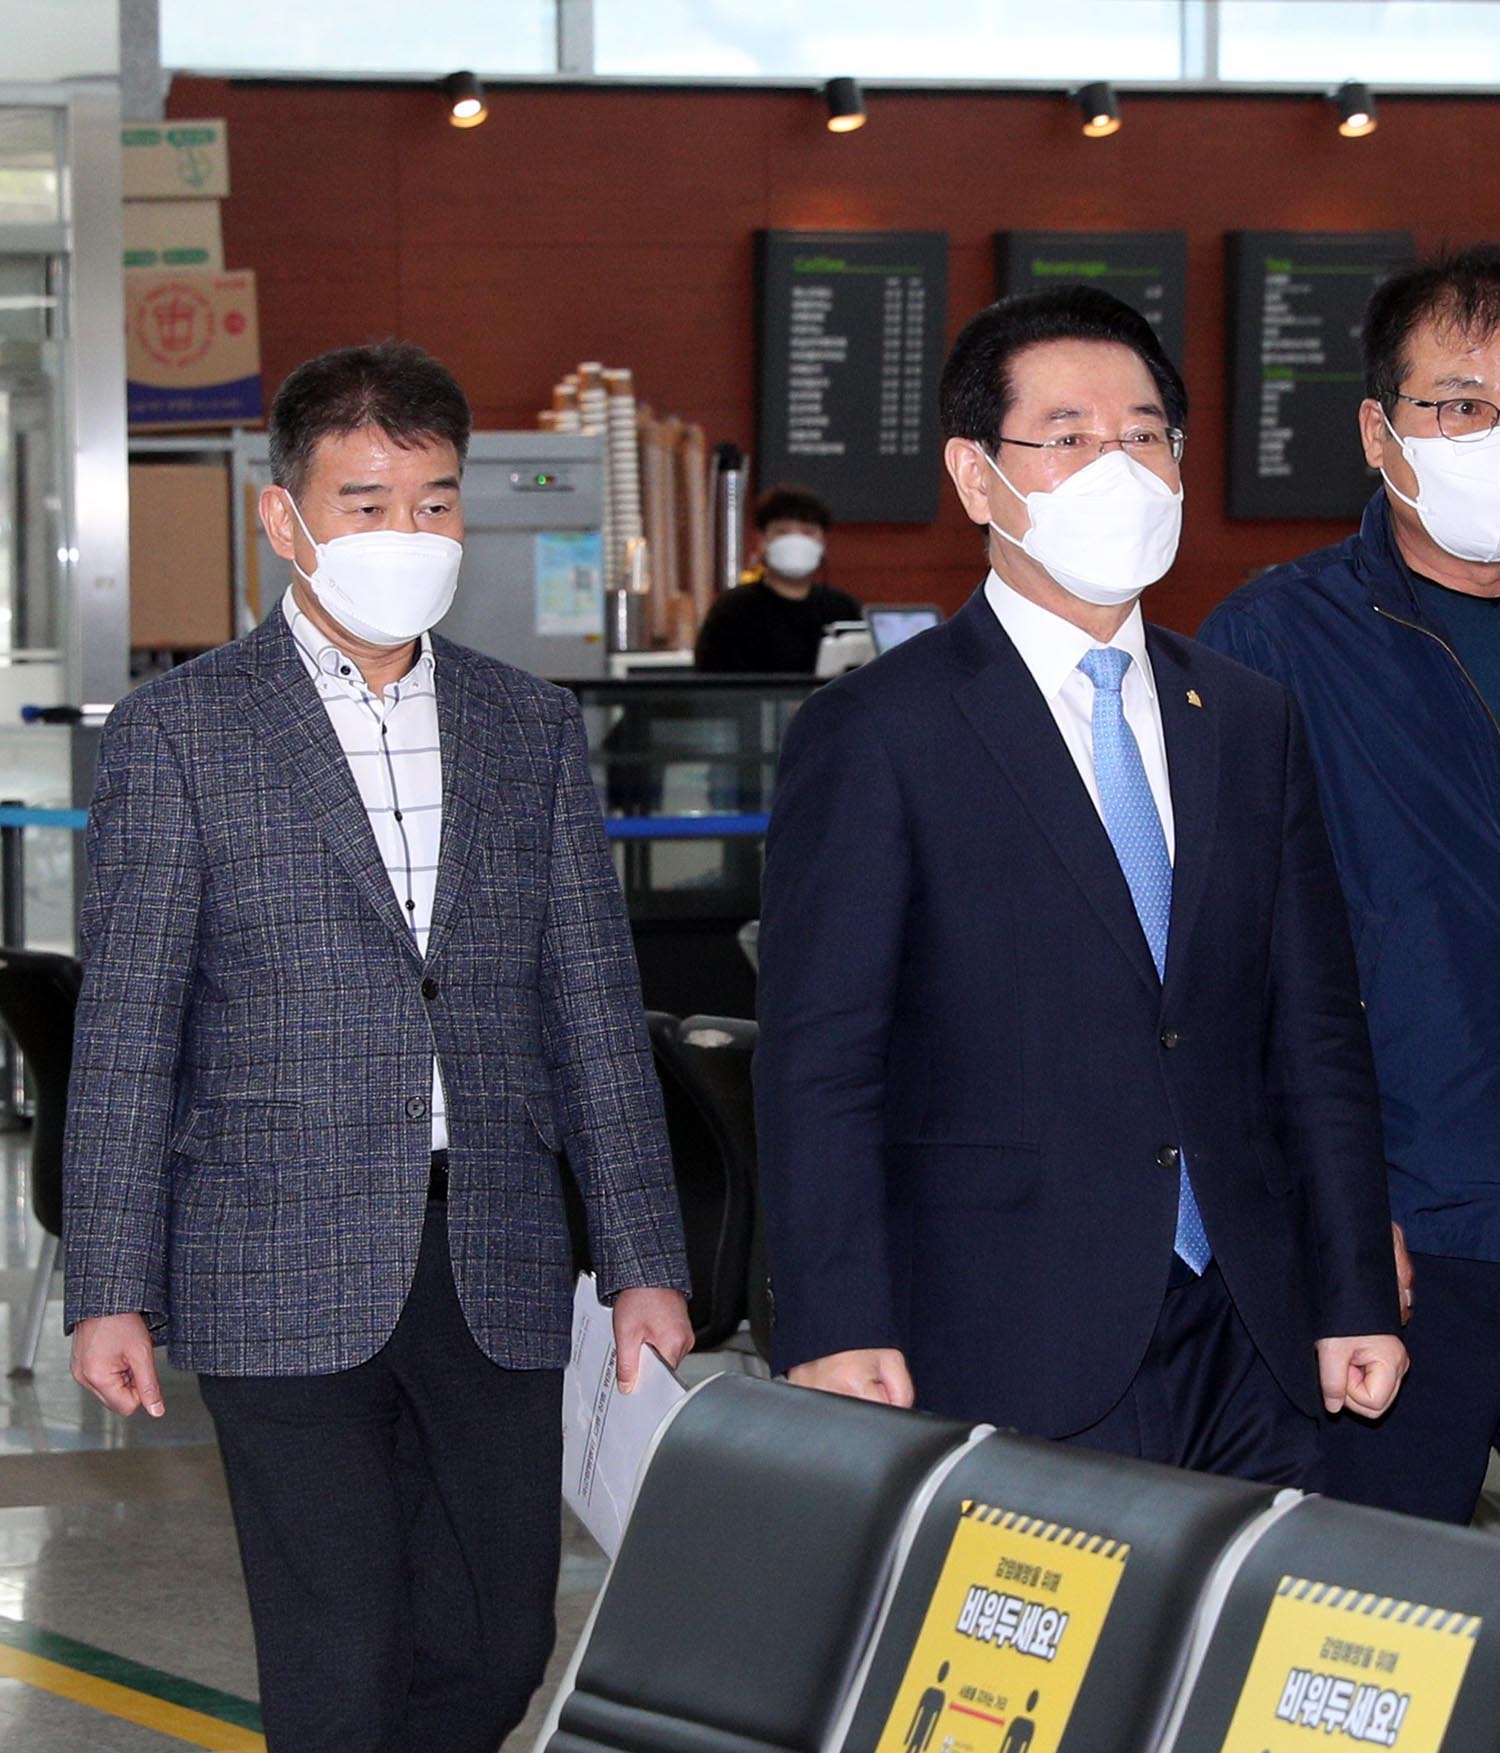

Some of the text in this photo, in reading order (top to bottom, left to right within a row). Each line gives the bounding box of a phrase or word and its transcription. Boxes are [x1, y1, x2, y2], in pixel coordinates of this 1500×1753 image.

[996, 1557, 1062, 1593] 감염예방을 위해
[956, 1584, 1069, 1662] 비워두세요!
[1319, 1636, 1400, 1674] 감염예방을 위해
[1275, 1666, 1411, 1748] 비워두세요!
